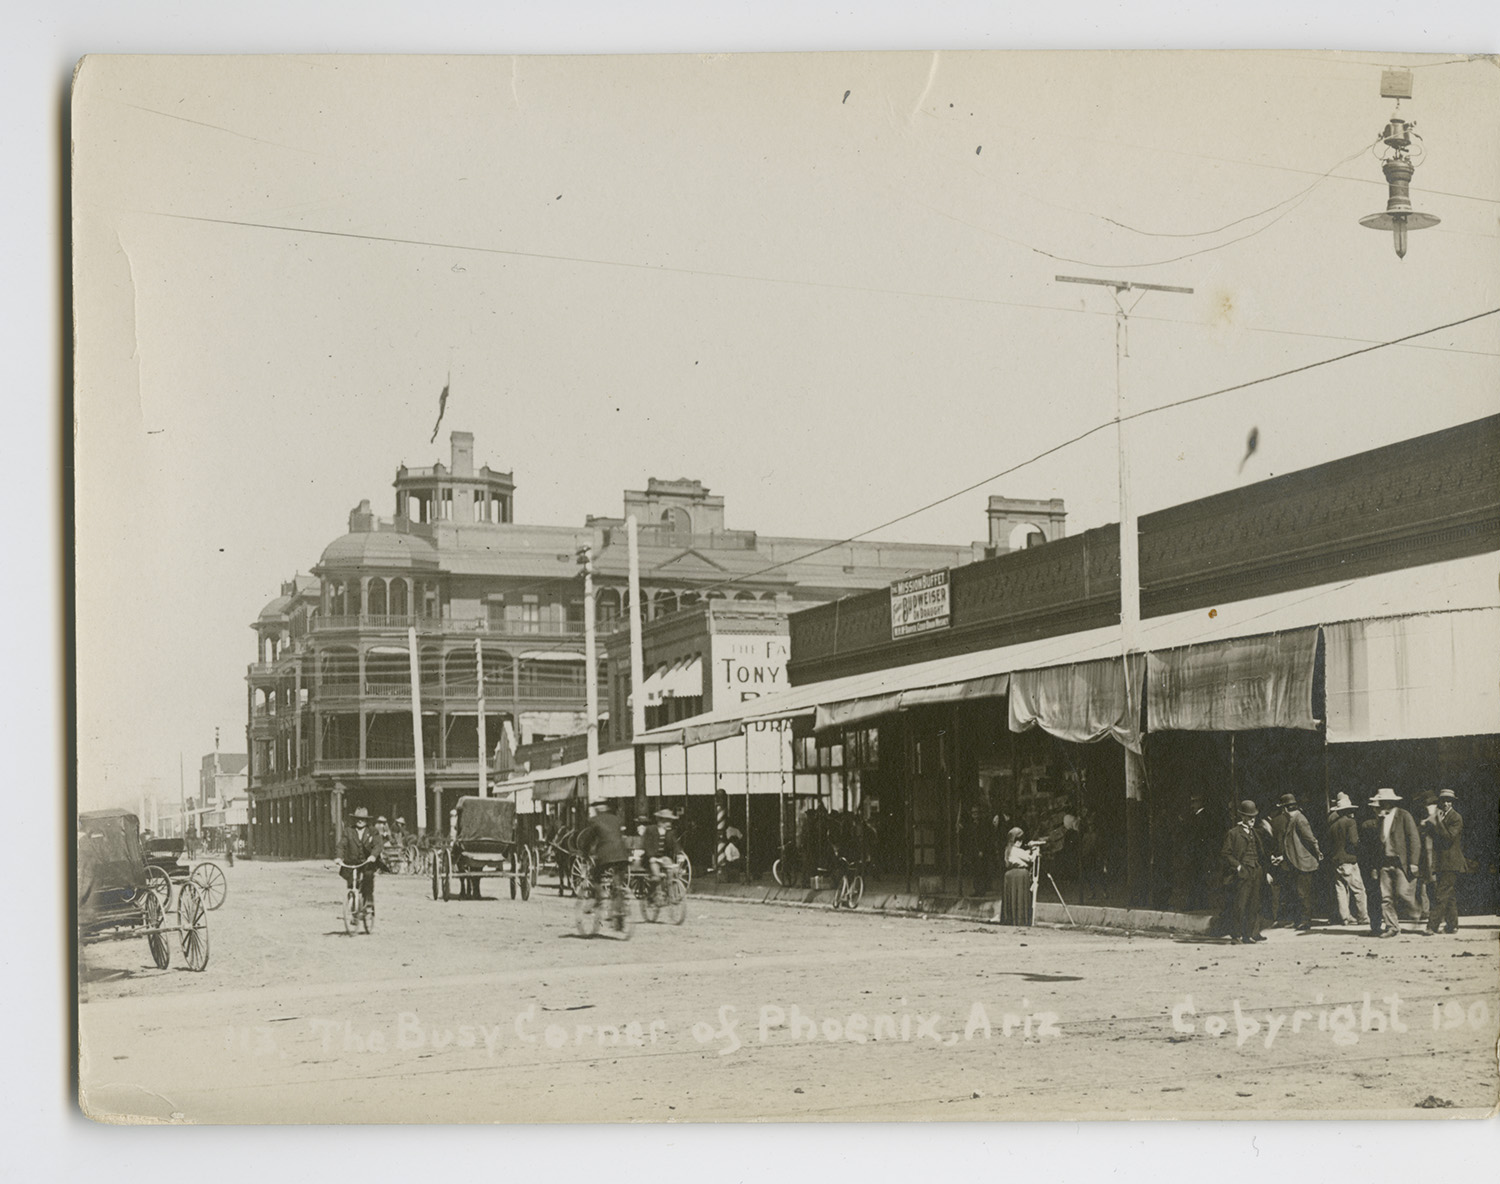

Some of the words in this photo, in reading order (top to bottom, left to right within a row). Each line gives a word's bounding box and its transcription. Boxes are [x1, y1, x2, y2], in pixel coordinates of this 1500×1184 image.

[922, 572, 945, 589] BUFFET
[902, 588, 946, 622] BUDWEISER
[721, 658, 779, 683] TONY
